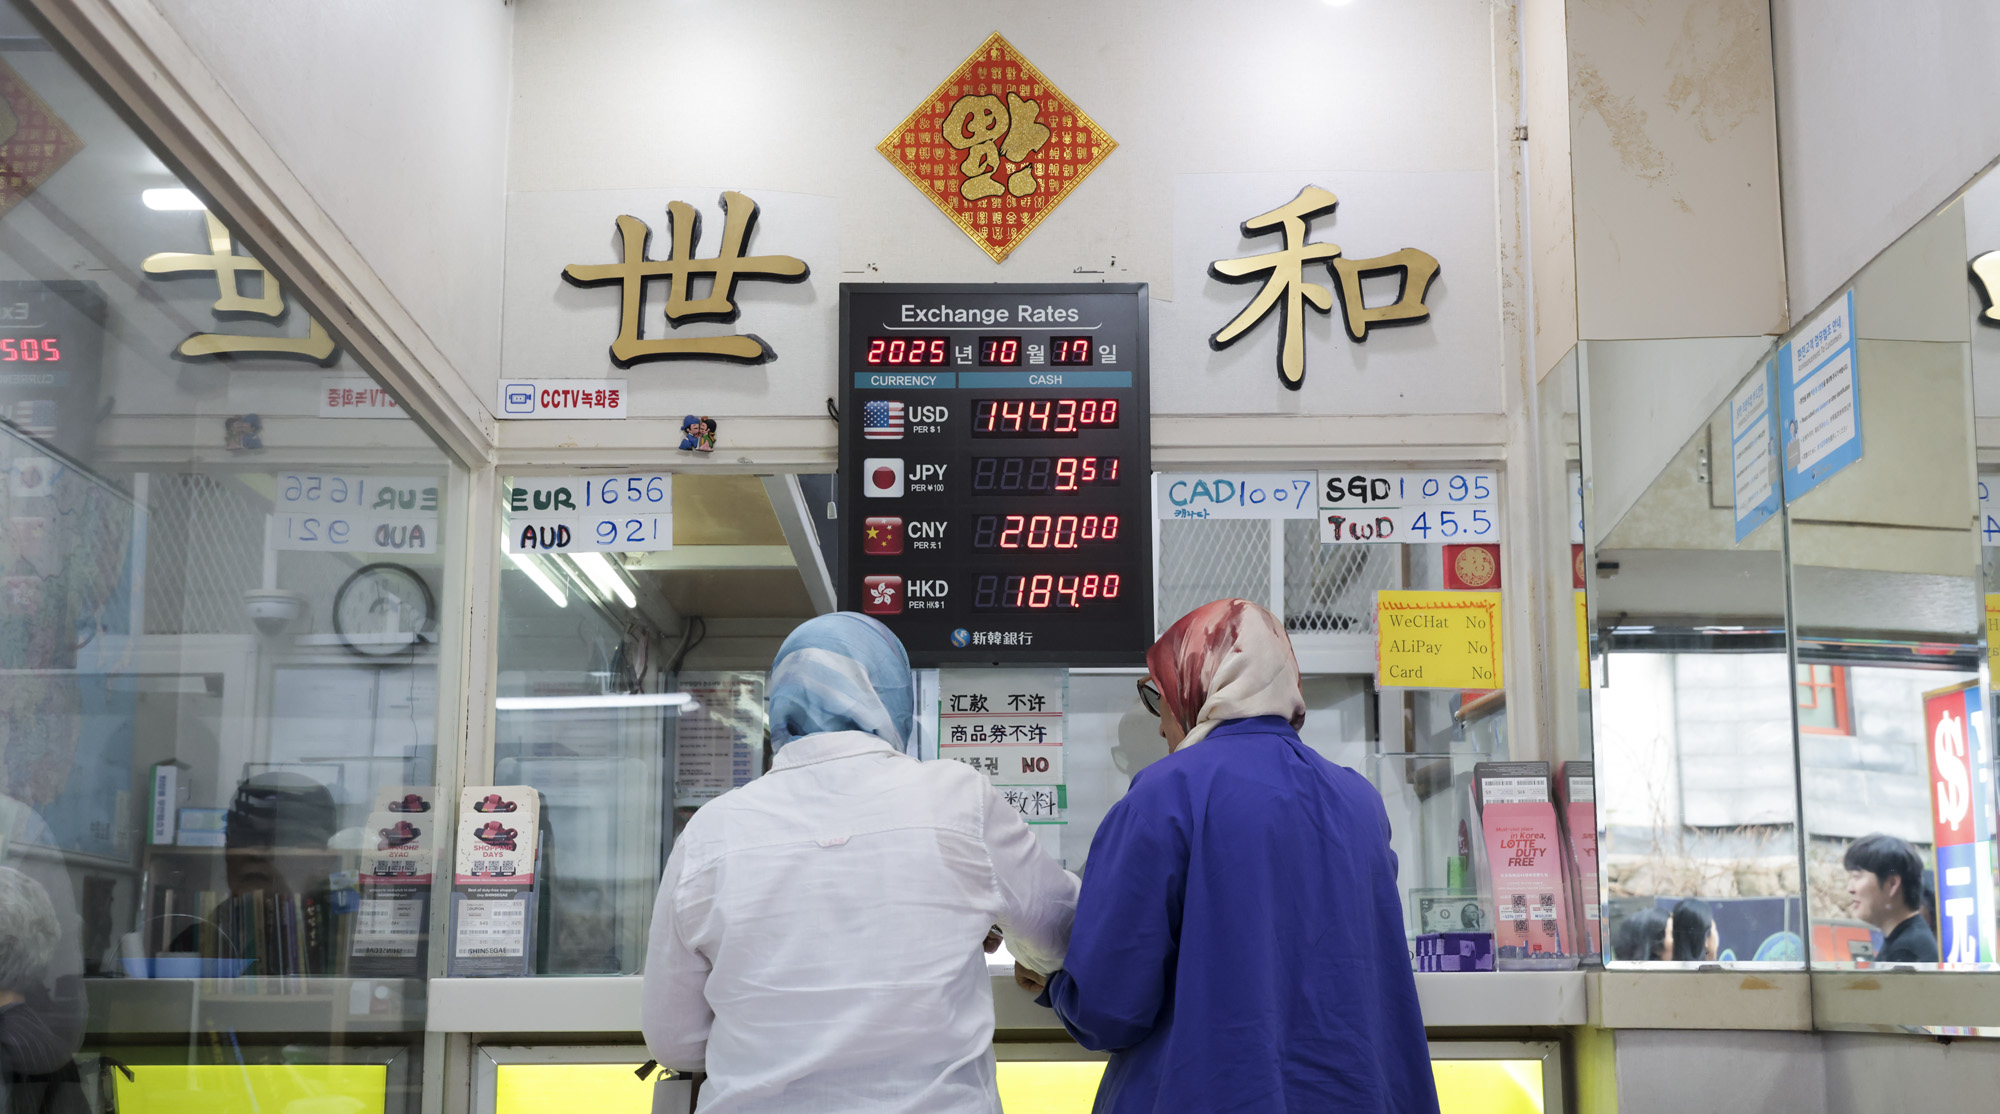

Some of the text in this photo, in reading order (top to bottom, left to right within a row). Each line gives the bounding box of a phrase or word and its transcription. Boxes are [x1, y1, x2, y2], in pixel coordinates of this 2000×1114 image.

[561, 190, 810, 369] 世
[1207, 184, 1441, 391] 和
[901, 304, 1079, 325] Exchange Rates
[868, 340, 1117, 364] 2025 년 10 월 17 일
[871, 375, 937, 386] CURRENCY
[1028, 374, 1063, 385] CASH
[540, 389, 620, 409] CCTV녹화중
[908, 405, 949, 423] USD
[908, 464, 948, 481] JPY
[1055, 458, 1118, 491] 9.51
[511, 477, 664, 511] EUR 1656
[911, 484, 926, 492] PER
[1169, 478, 1311, 510] CAD 1007
[1325, 475, 1491, 503] SGD 1095
[520, 518, 658, 549] AUD 921
[908, 521, 948, 538] CNY
[1000, 516, 1119, 548] 200.00
[1410, 509, 1492, 539] 45.5
[914, 541, 929, 549] PER
[908, 580, 949, 597] HKD
[1016, 574, 1120, 608] 184.80
[1389, 614, 1486, 629] WeCHat No
[972, 631, 1034, 646] 新韓銀行
[1389, 639, 1488, 655] ALiPay No
[1389, 664, 1492, 680] Card No
[949, 693, 1046, 713] 汇款 不许
[950, 723, 1048, 744] 商品券不许
[953, 756, 1049, 776] 품권 NO
[1500, 839, 1536, 848] LOTTE
[1520, 832, 1546, 840] Korea,
[1508, 857, 1535, 867] FREE
[1515, 848, 1547, 858] DUTY
